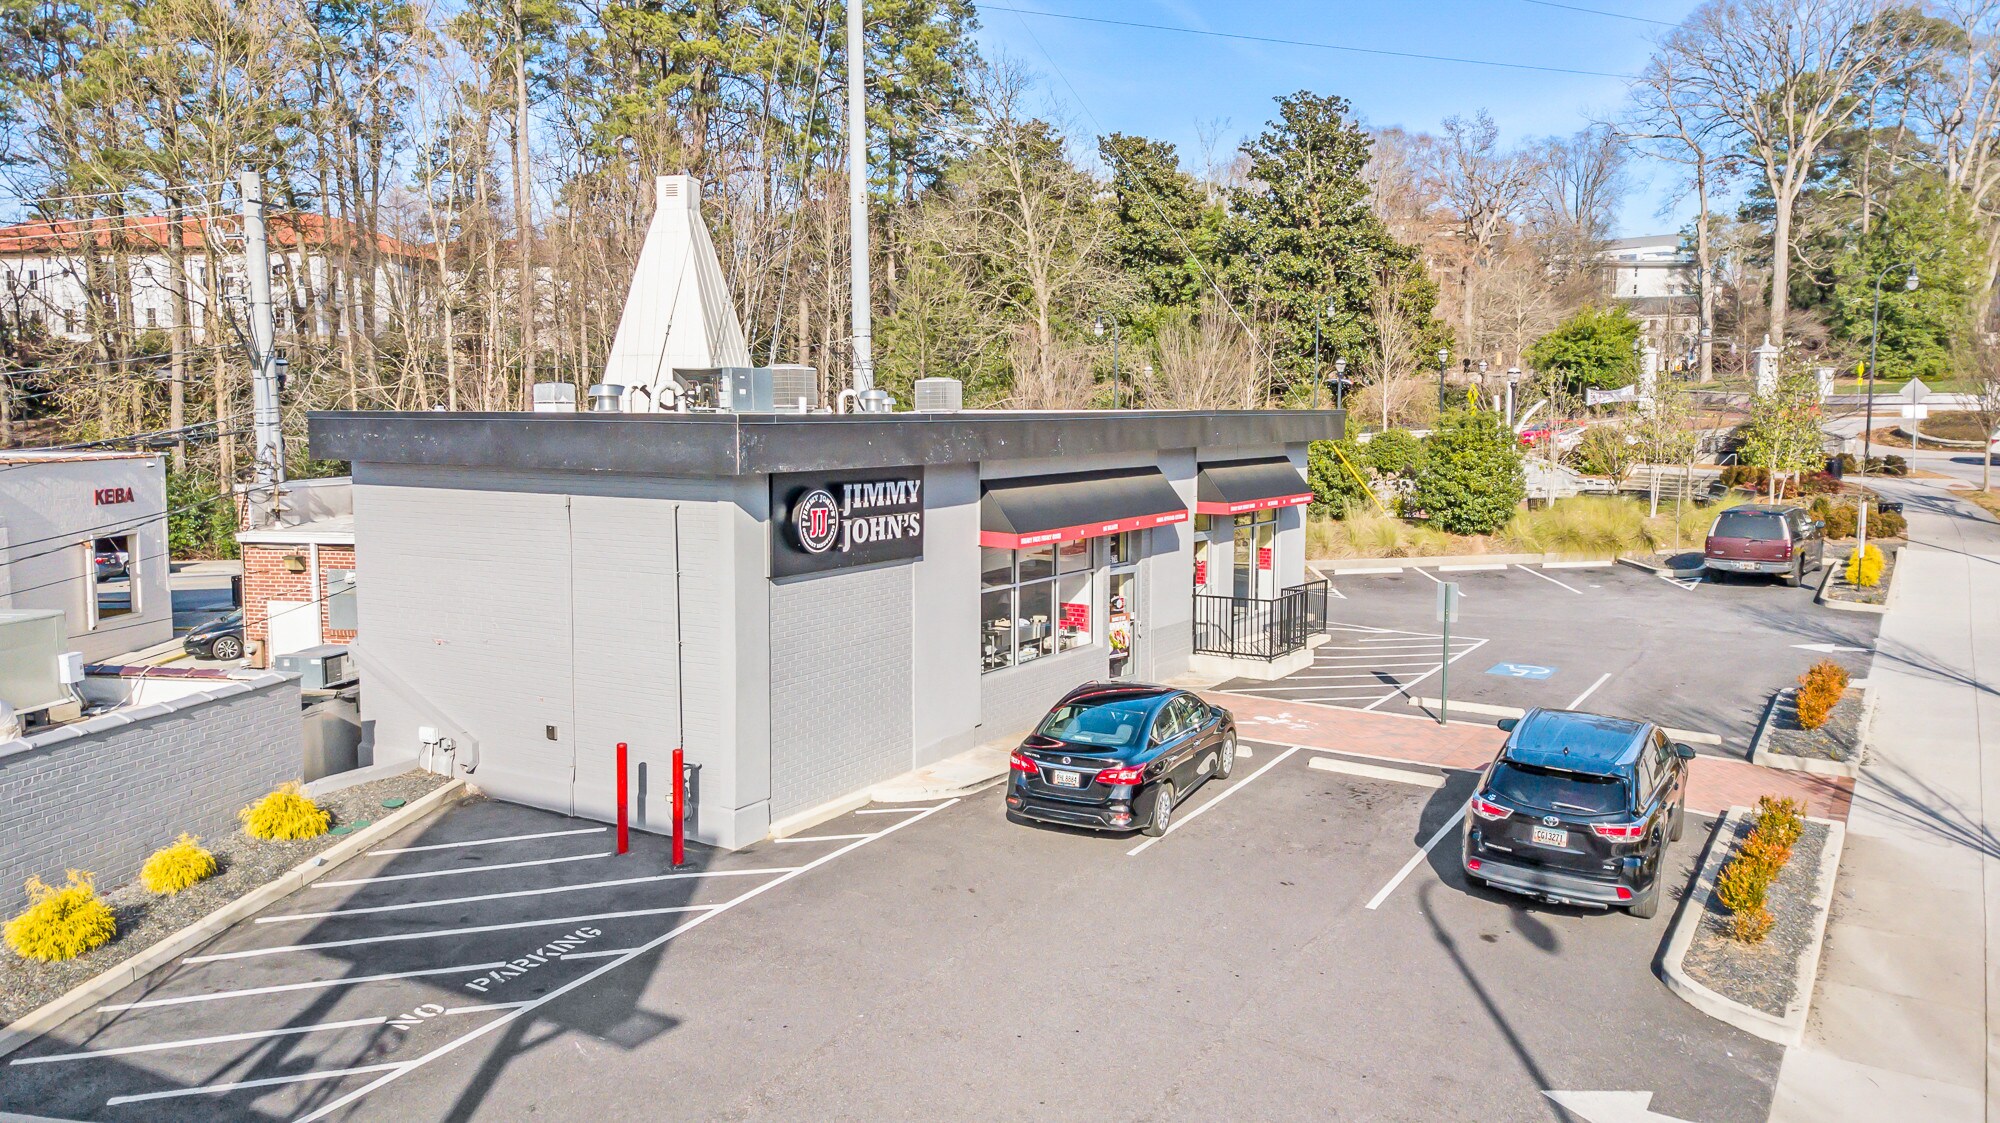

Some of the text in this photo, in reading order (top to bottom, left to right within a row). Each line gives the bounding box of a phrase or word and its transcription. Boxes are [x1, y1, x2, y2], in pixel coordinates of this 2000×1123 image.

[94, 486, 135, 506] KEBA
[802, 495, 819, 519] JIMMY
[843, 480, 921, 516] JIMMY
[810, 508, 828, 538] JJ
[843, 513, 920, 552] JOHN'S
[386, 927, 602, 1031] NO PARKING
